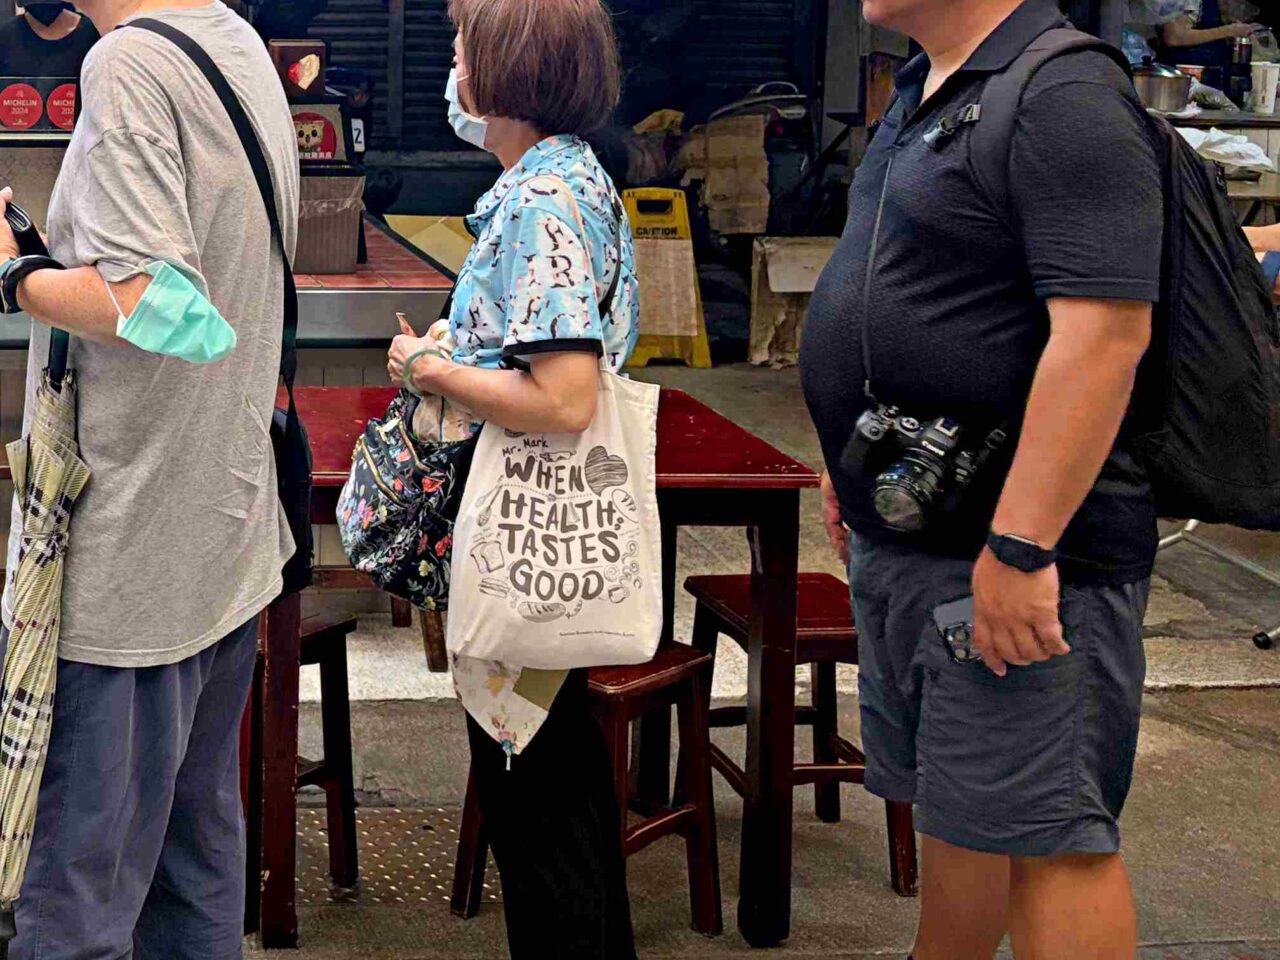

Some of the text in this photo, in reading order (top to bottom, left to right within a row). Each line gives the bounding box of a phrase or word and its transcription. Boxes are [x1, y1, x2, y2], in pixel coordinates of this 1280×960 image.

[3, 99, 37, 107] MICHELIN
[61, 107, 75, 115] 202
[353, 127, 363, 145] 2
[635, 226, 678, 236] CAUTION
[502, 438, 548, 457] Mr. Mark
[505, 455, 585, 494] WHEN
[500, 490, 616, 533] HEALTH
[498, 523, 621, 567] TASTES
[509, 558, 604, 601] GOOD
